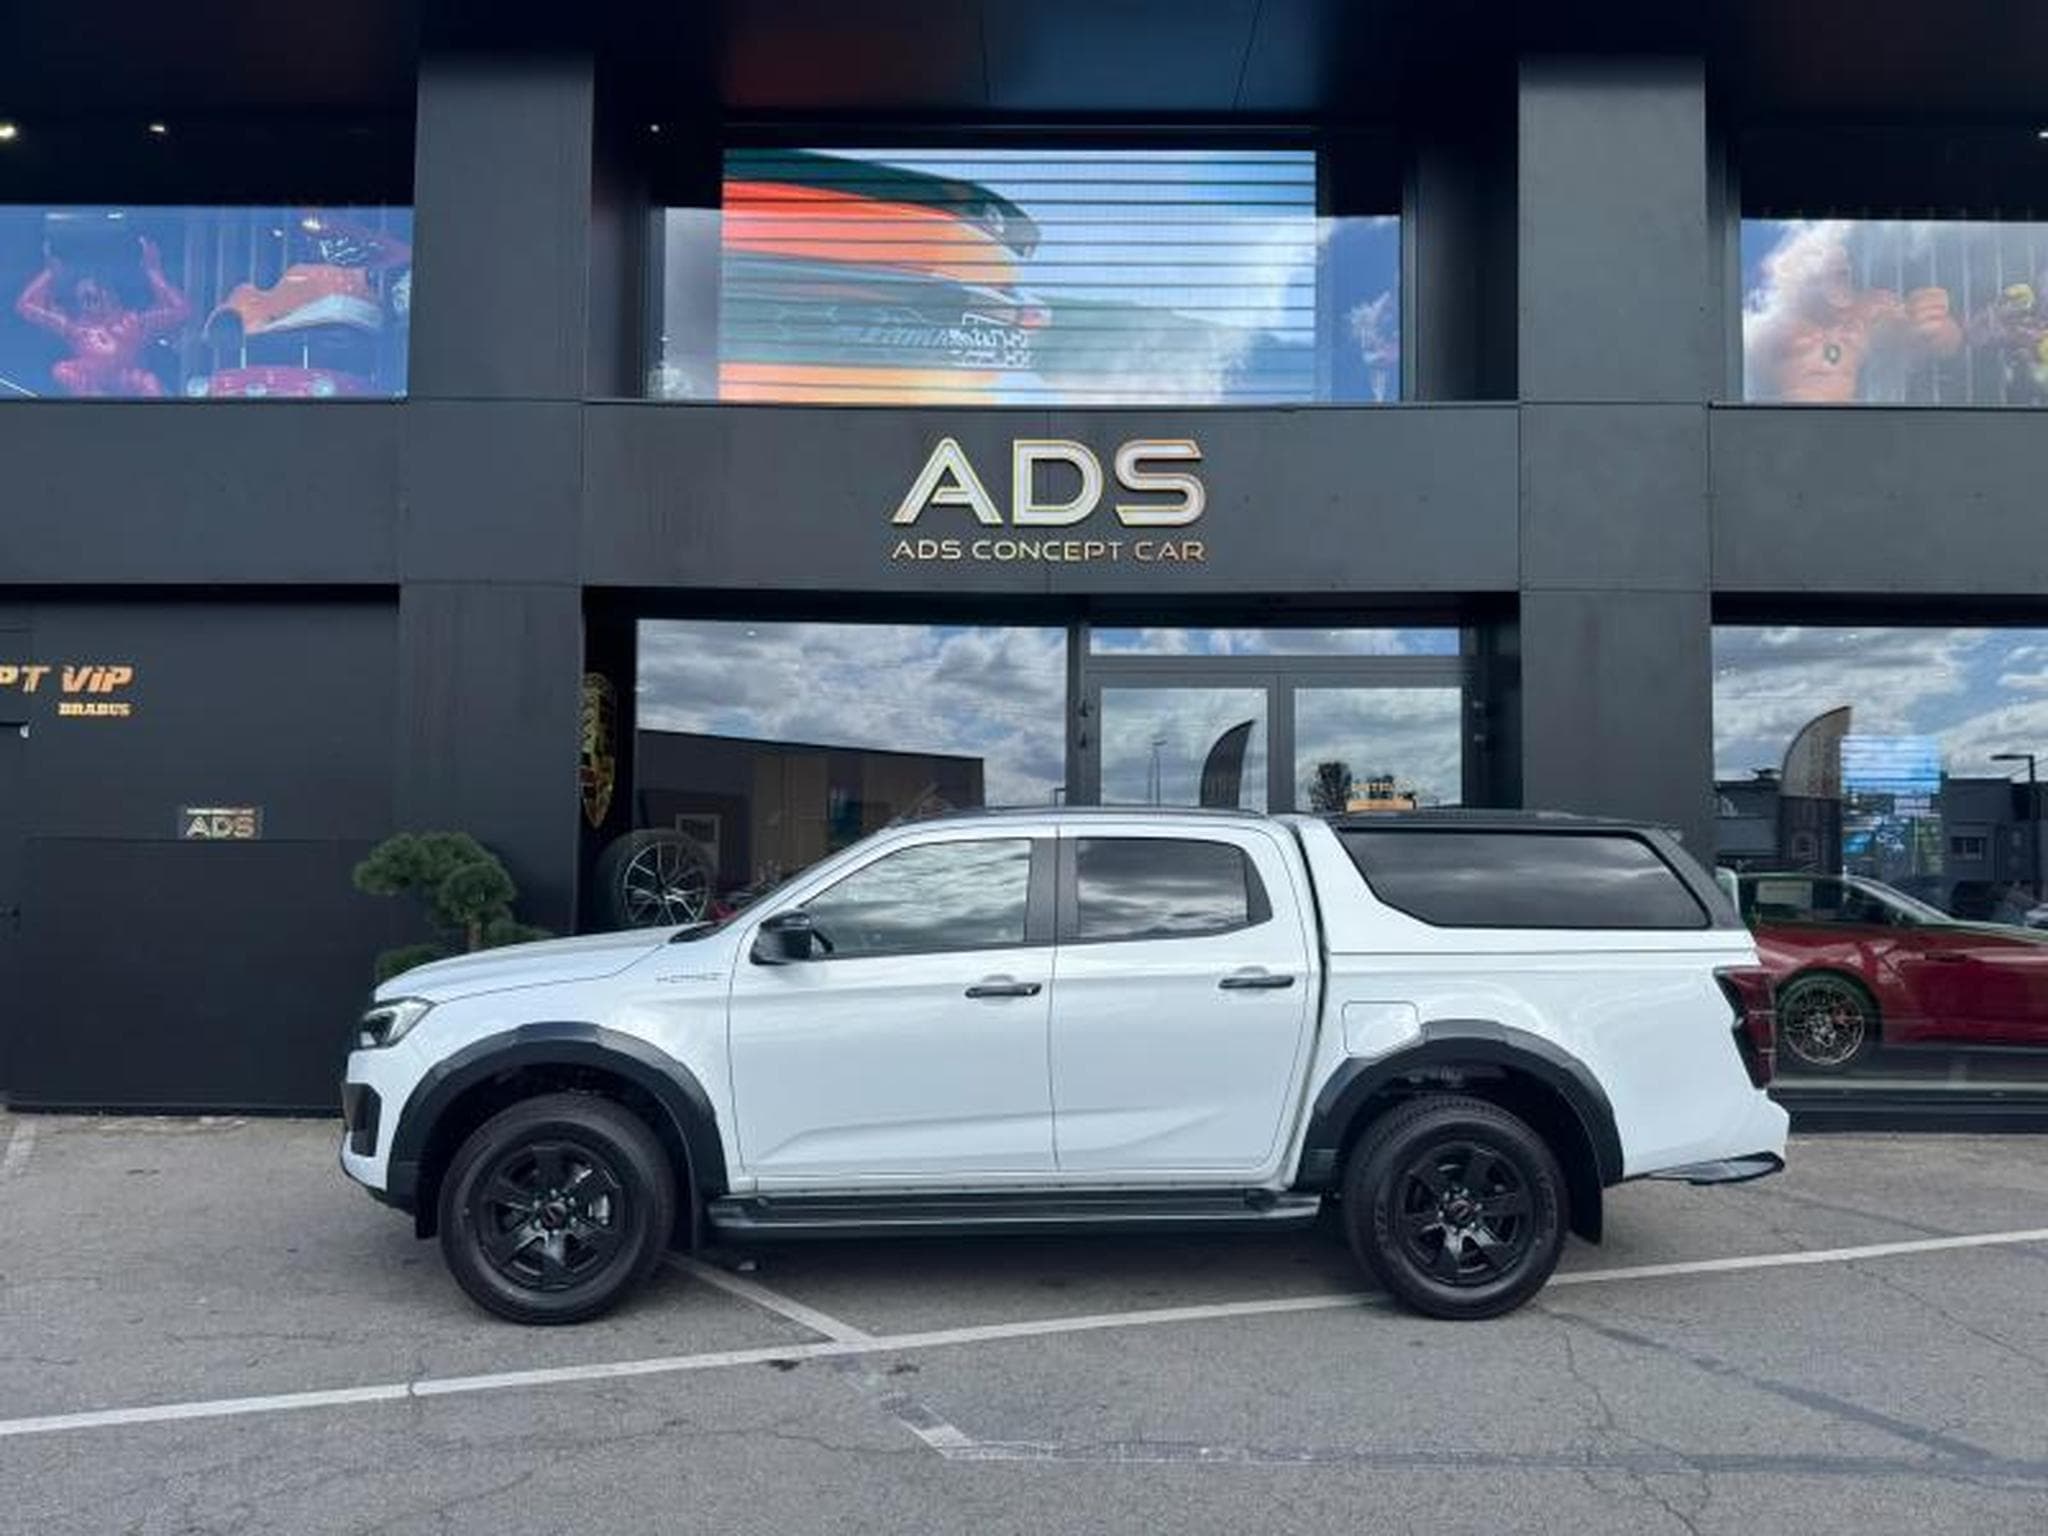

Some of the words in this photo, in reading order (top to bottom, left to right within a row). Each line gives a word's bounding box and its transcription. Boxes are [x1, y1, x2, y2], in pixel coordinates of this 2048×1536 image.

[892, 438, 1206, 525] ADS
[892, 540, 961, 560] ADS
[972, 540, 1122, 560] CONCEPT
[1135, 541, 1205, 560] CAR
[186, 816, 255, 838] ADS
